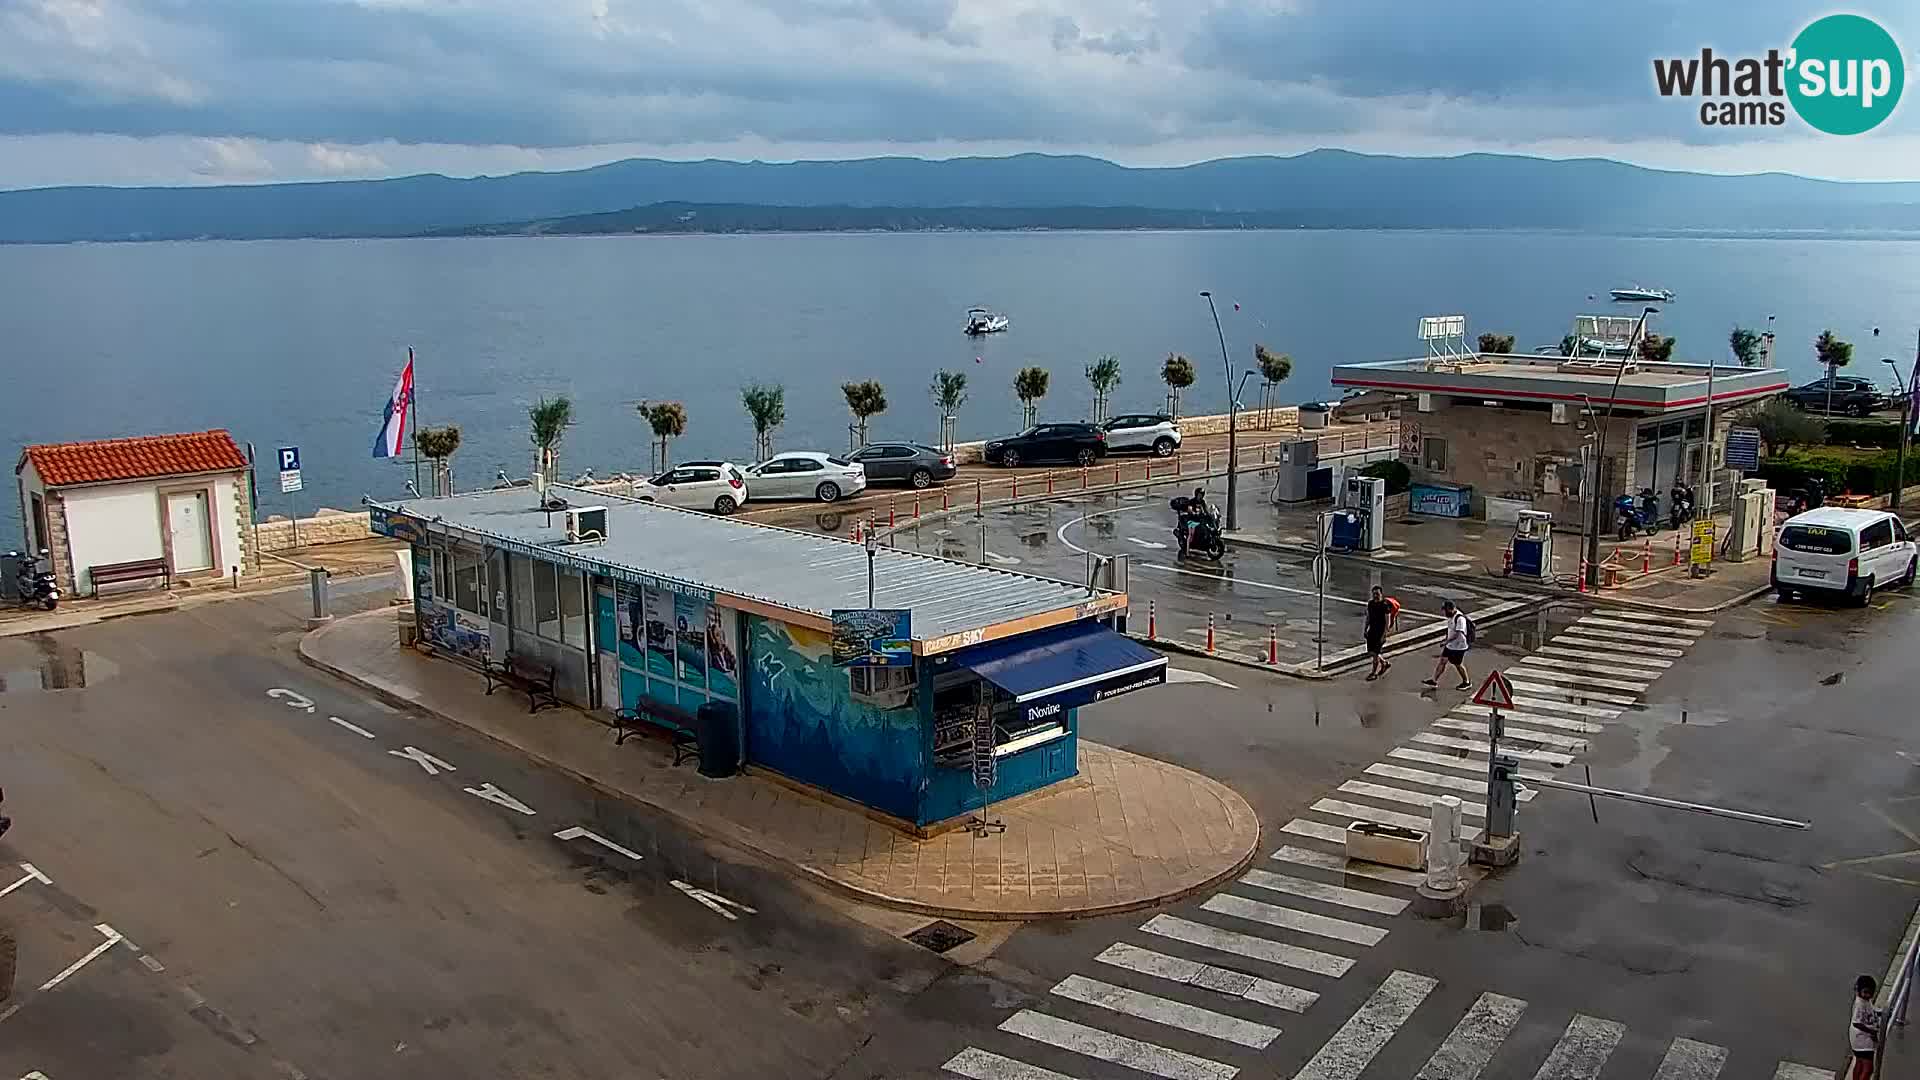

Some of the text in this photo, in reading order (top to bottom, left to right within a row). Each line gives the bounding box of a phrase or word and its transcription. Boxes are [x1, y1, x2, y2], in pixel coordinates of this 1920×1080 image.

[283, 450, 295, 468] P
[1807, 527, 1827, 536] TAXI
[610, 568, 625, 579] BUS
[625, 571, 656, 587] STATION
[659, 579, 683, 593] TICKET
[684, 584, 711, 600] OFFICE
[1028, 703, 1061, 721] iNovine
